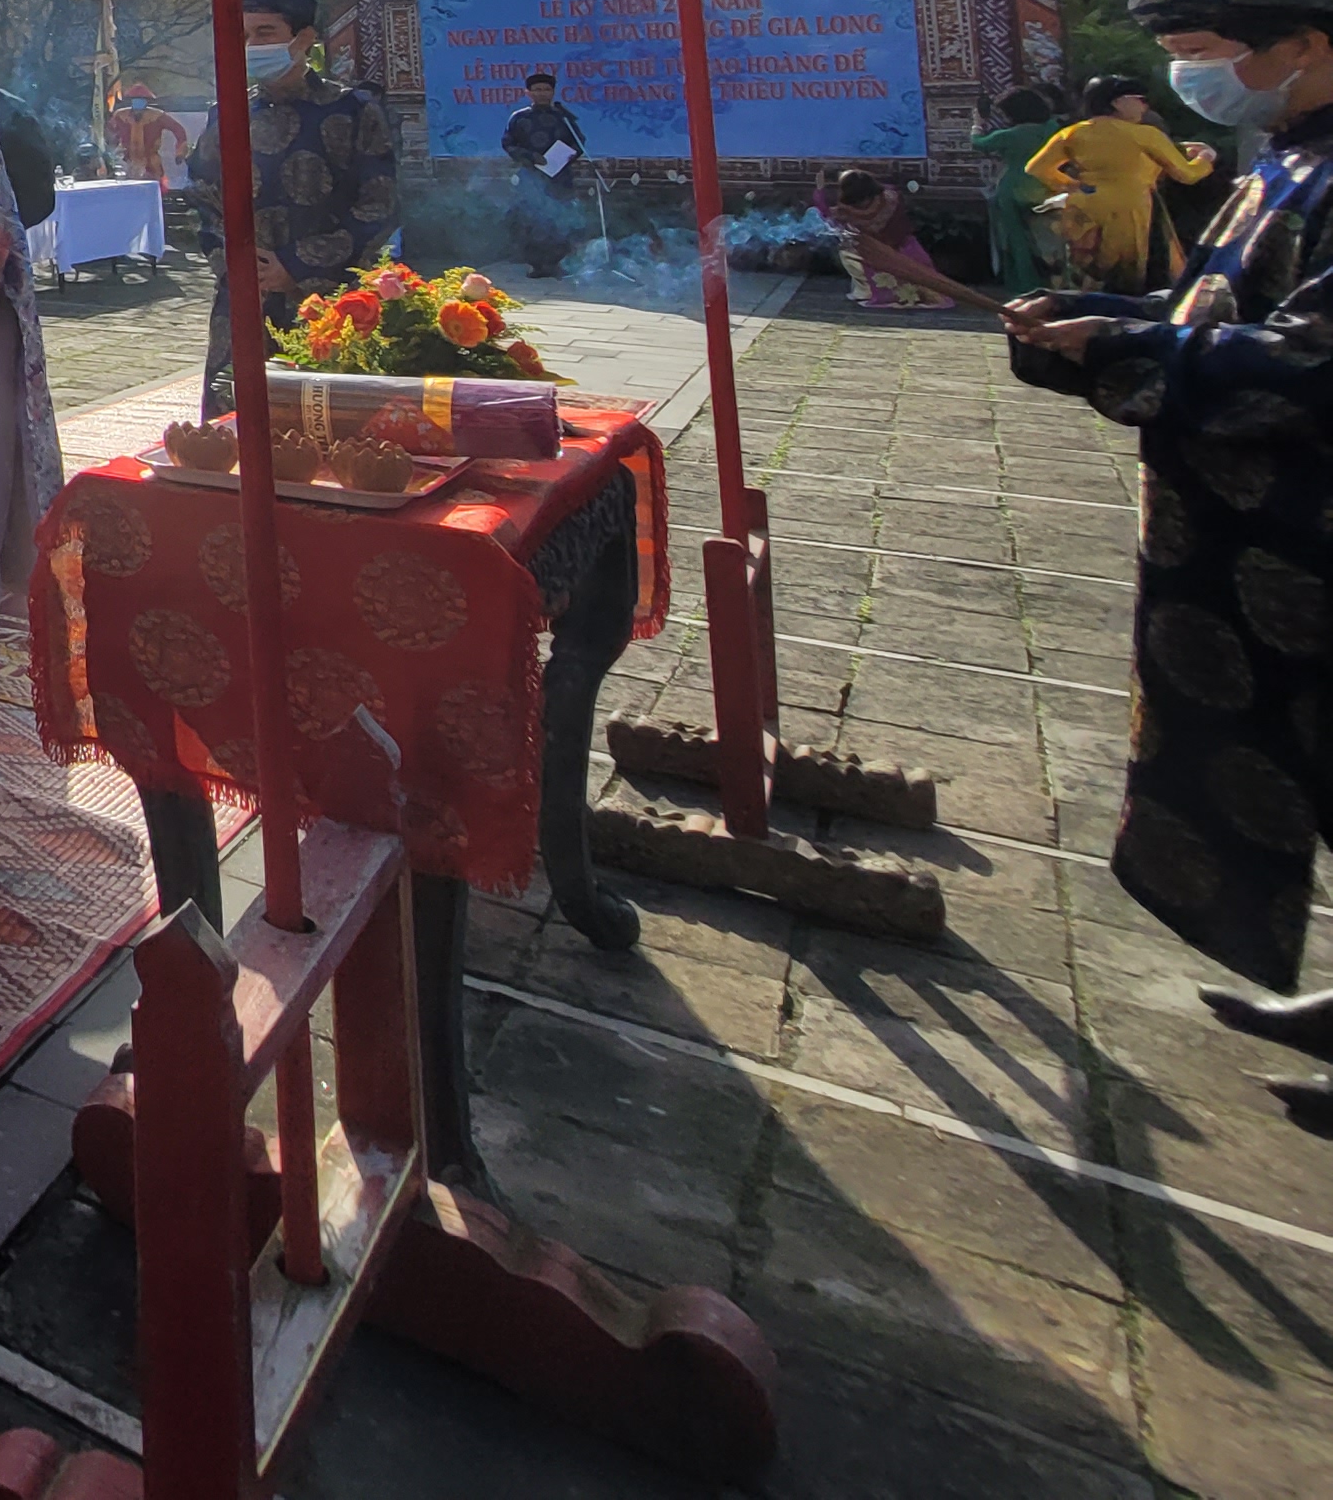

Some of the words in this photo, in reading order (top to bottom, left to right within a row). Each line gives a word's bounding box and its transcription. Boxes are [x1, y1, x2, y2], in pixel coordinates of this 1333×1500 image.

[645, 18, 725, 41] HOG
[730, 12, 763, 38] ĐẾ
[767, 16, 810, 37] GIA
[816, 13, 883, 36] LONG
[747, 50, 829, 74] HOÀNG
[833, 46, 867, 73] ĐẾ
[791, 74, 889, 100] NGUYỄN
